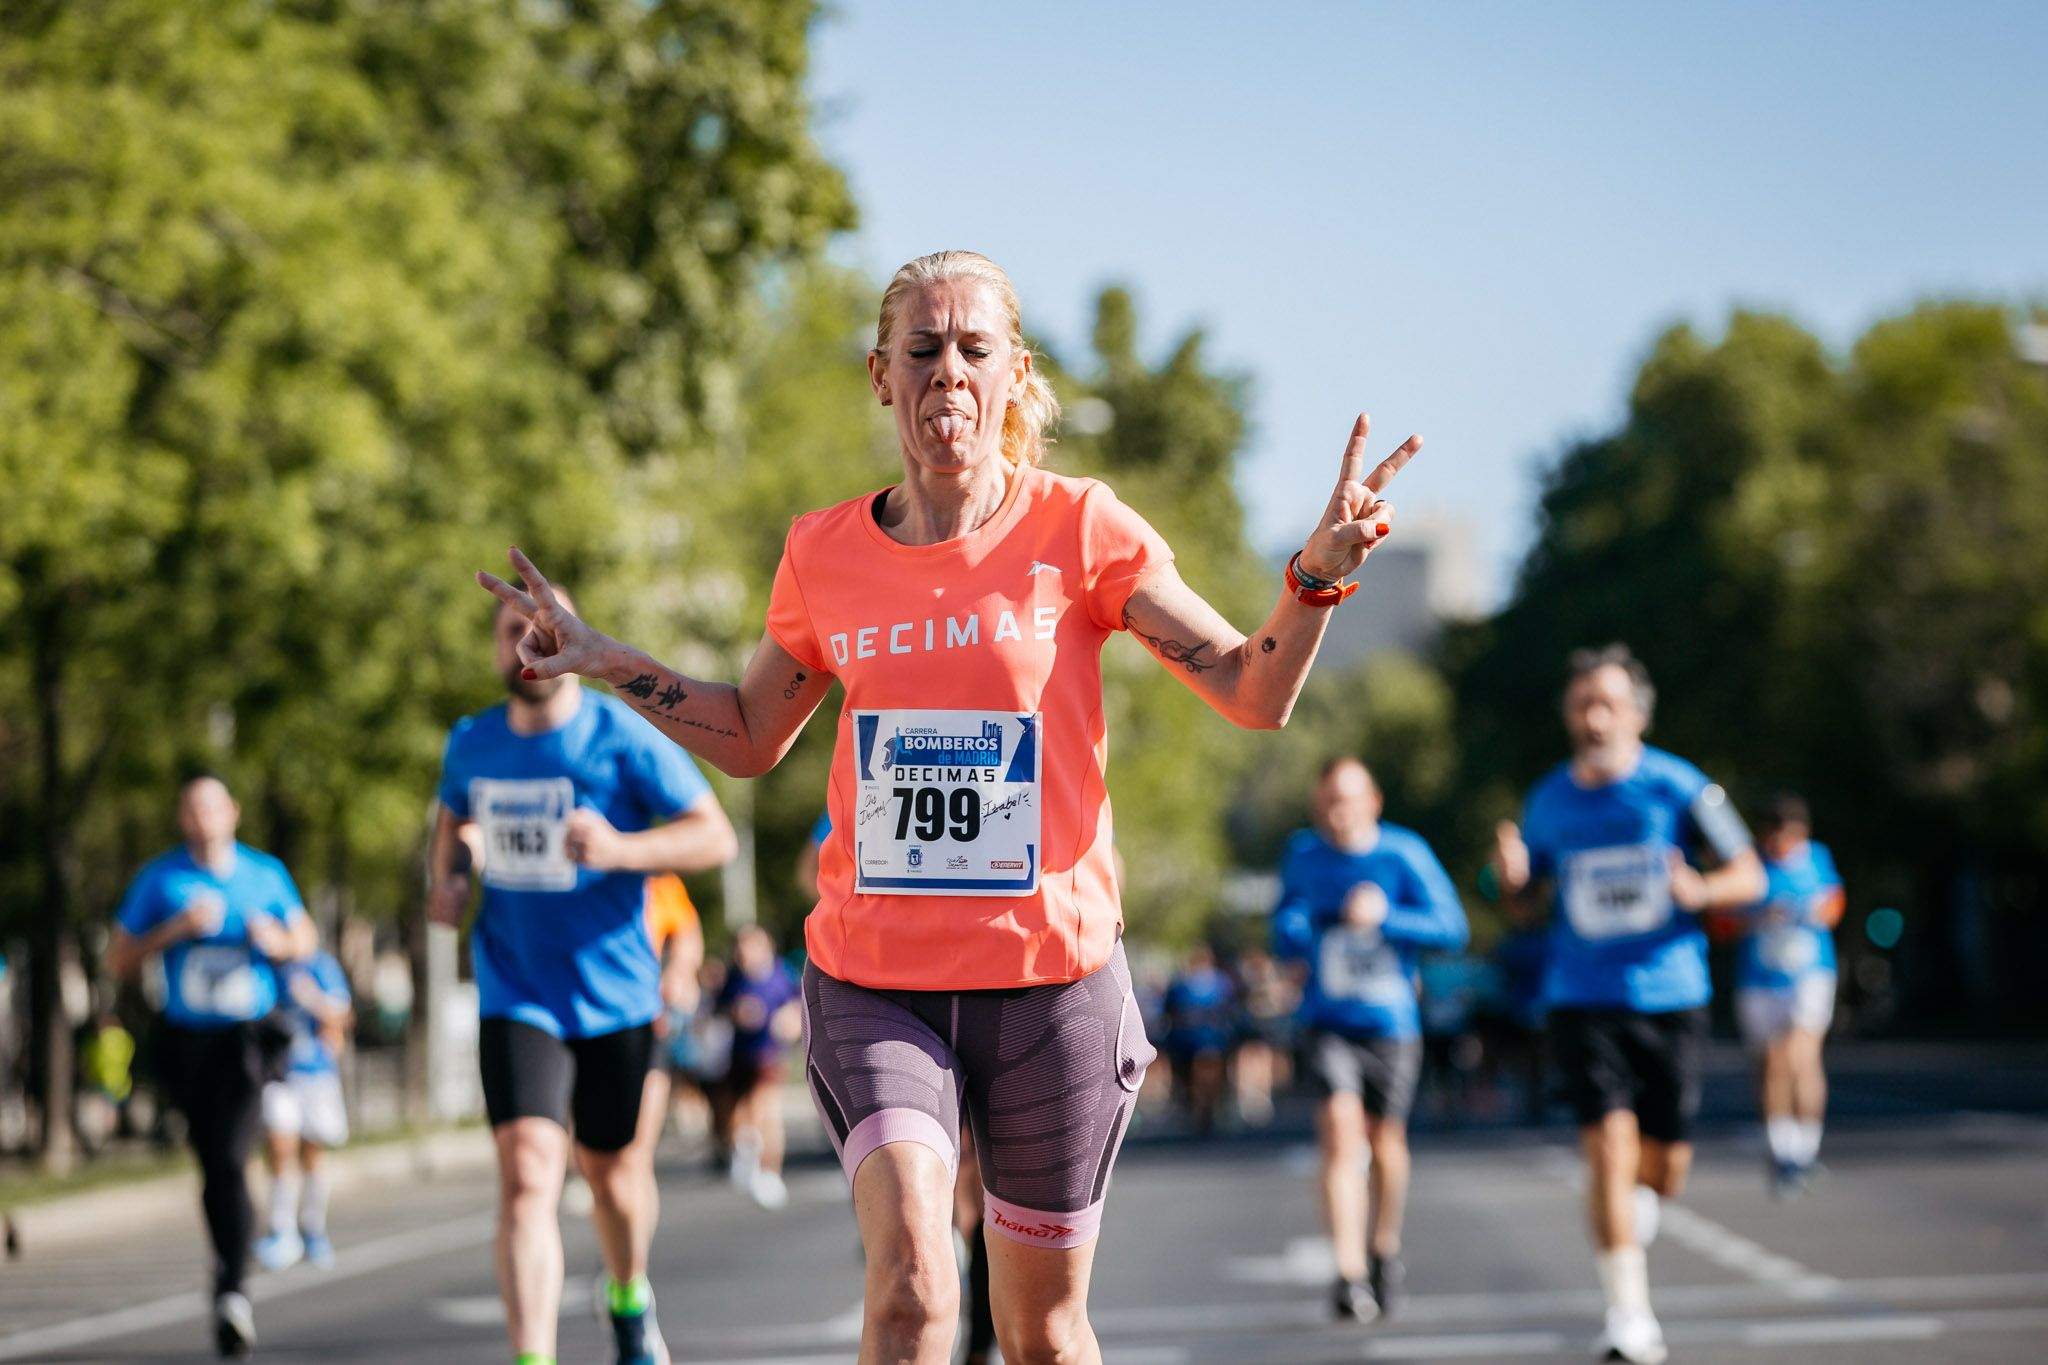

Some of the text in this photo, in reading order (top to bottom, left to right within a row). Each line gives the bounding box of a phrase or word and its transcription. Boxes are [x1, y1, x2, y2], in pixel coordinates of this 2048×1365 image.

[830, 607, 1057, 666] DECIMAS
[905, 727, 938, 735] CARRERA
[904, 736, 998, 751] BOMBEROS
[938, 751, 998, 765] de MADRID
[895, 767, 995, 783] DECIMAS
[893, 787, 981, 842] 799
